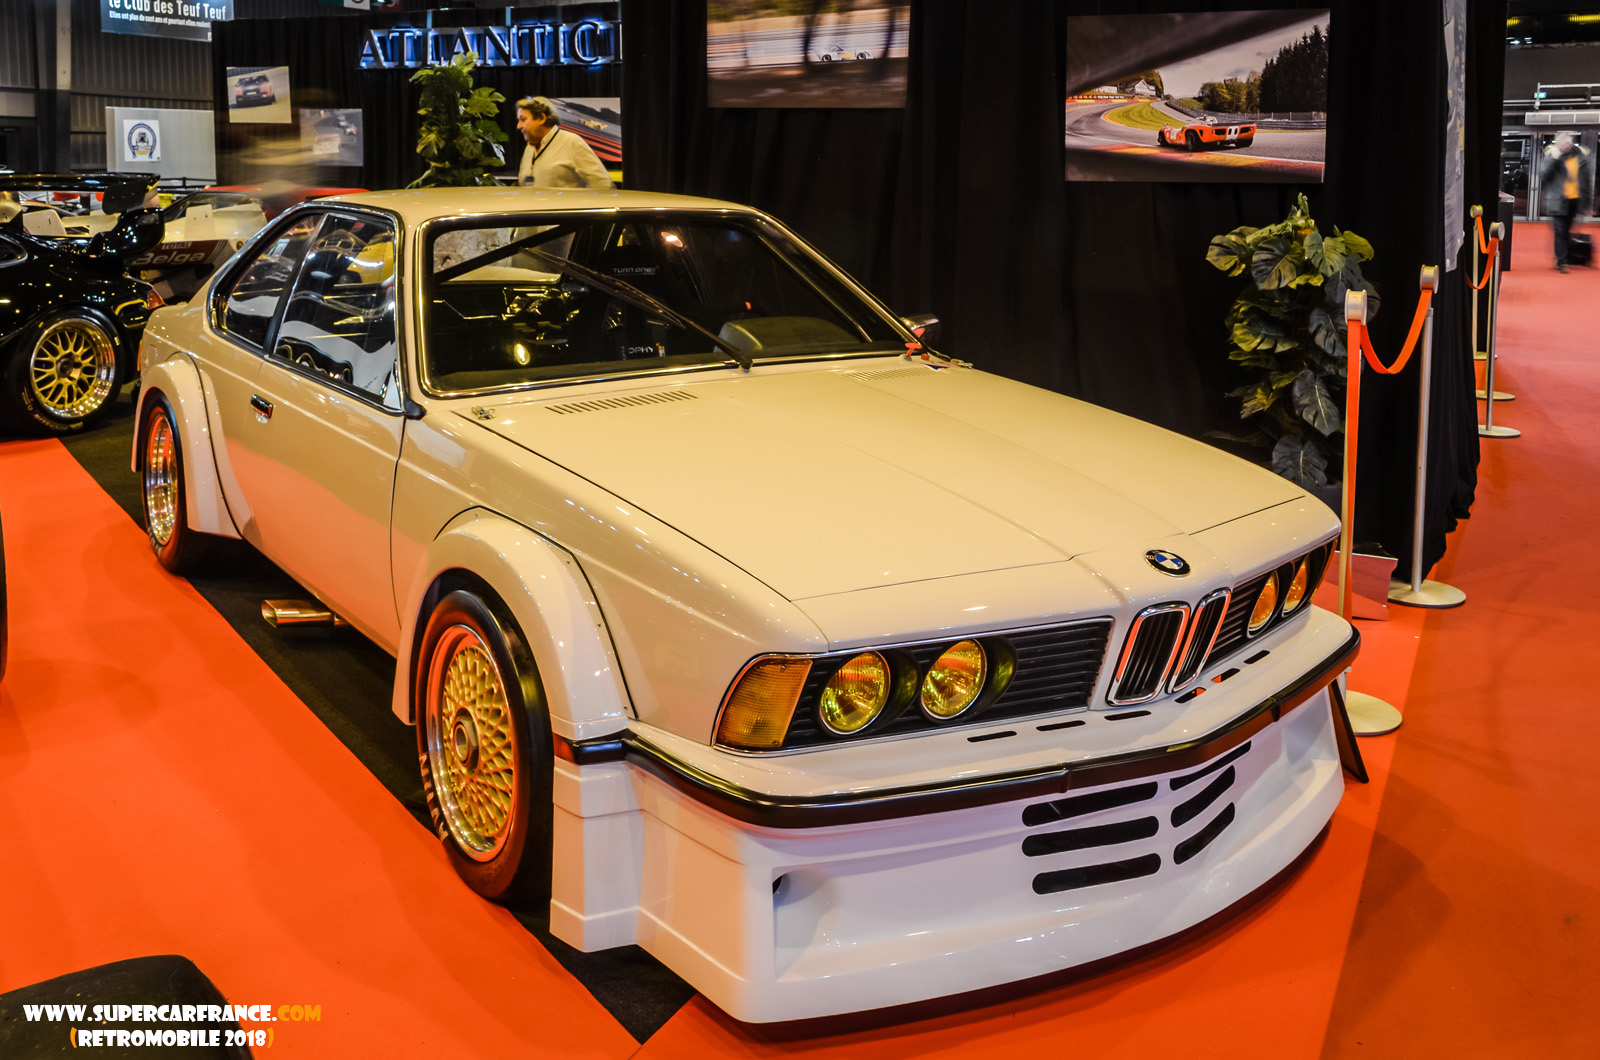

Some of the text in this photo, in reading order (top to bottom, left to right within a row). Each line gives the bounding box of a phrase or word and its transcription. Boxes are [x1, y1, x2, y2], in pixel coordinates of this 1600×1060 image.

[124, 0, 151, 12] Club
[153, 0, 174, 15] des
[176, 0, 200, 18] Teuf
[203, 3, 226, 20] Teuf
[131, 251, 206, 265] Belga
